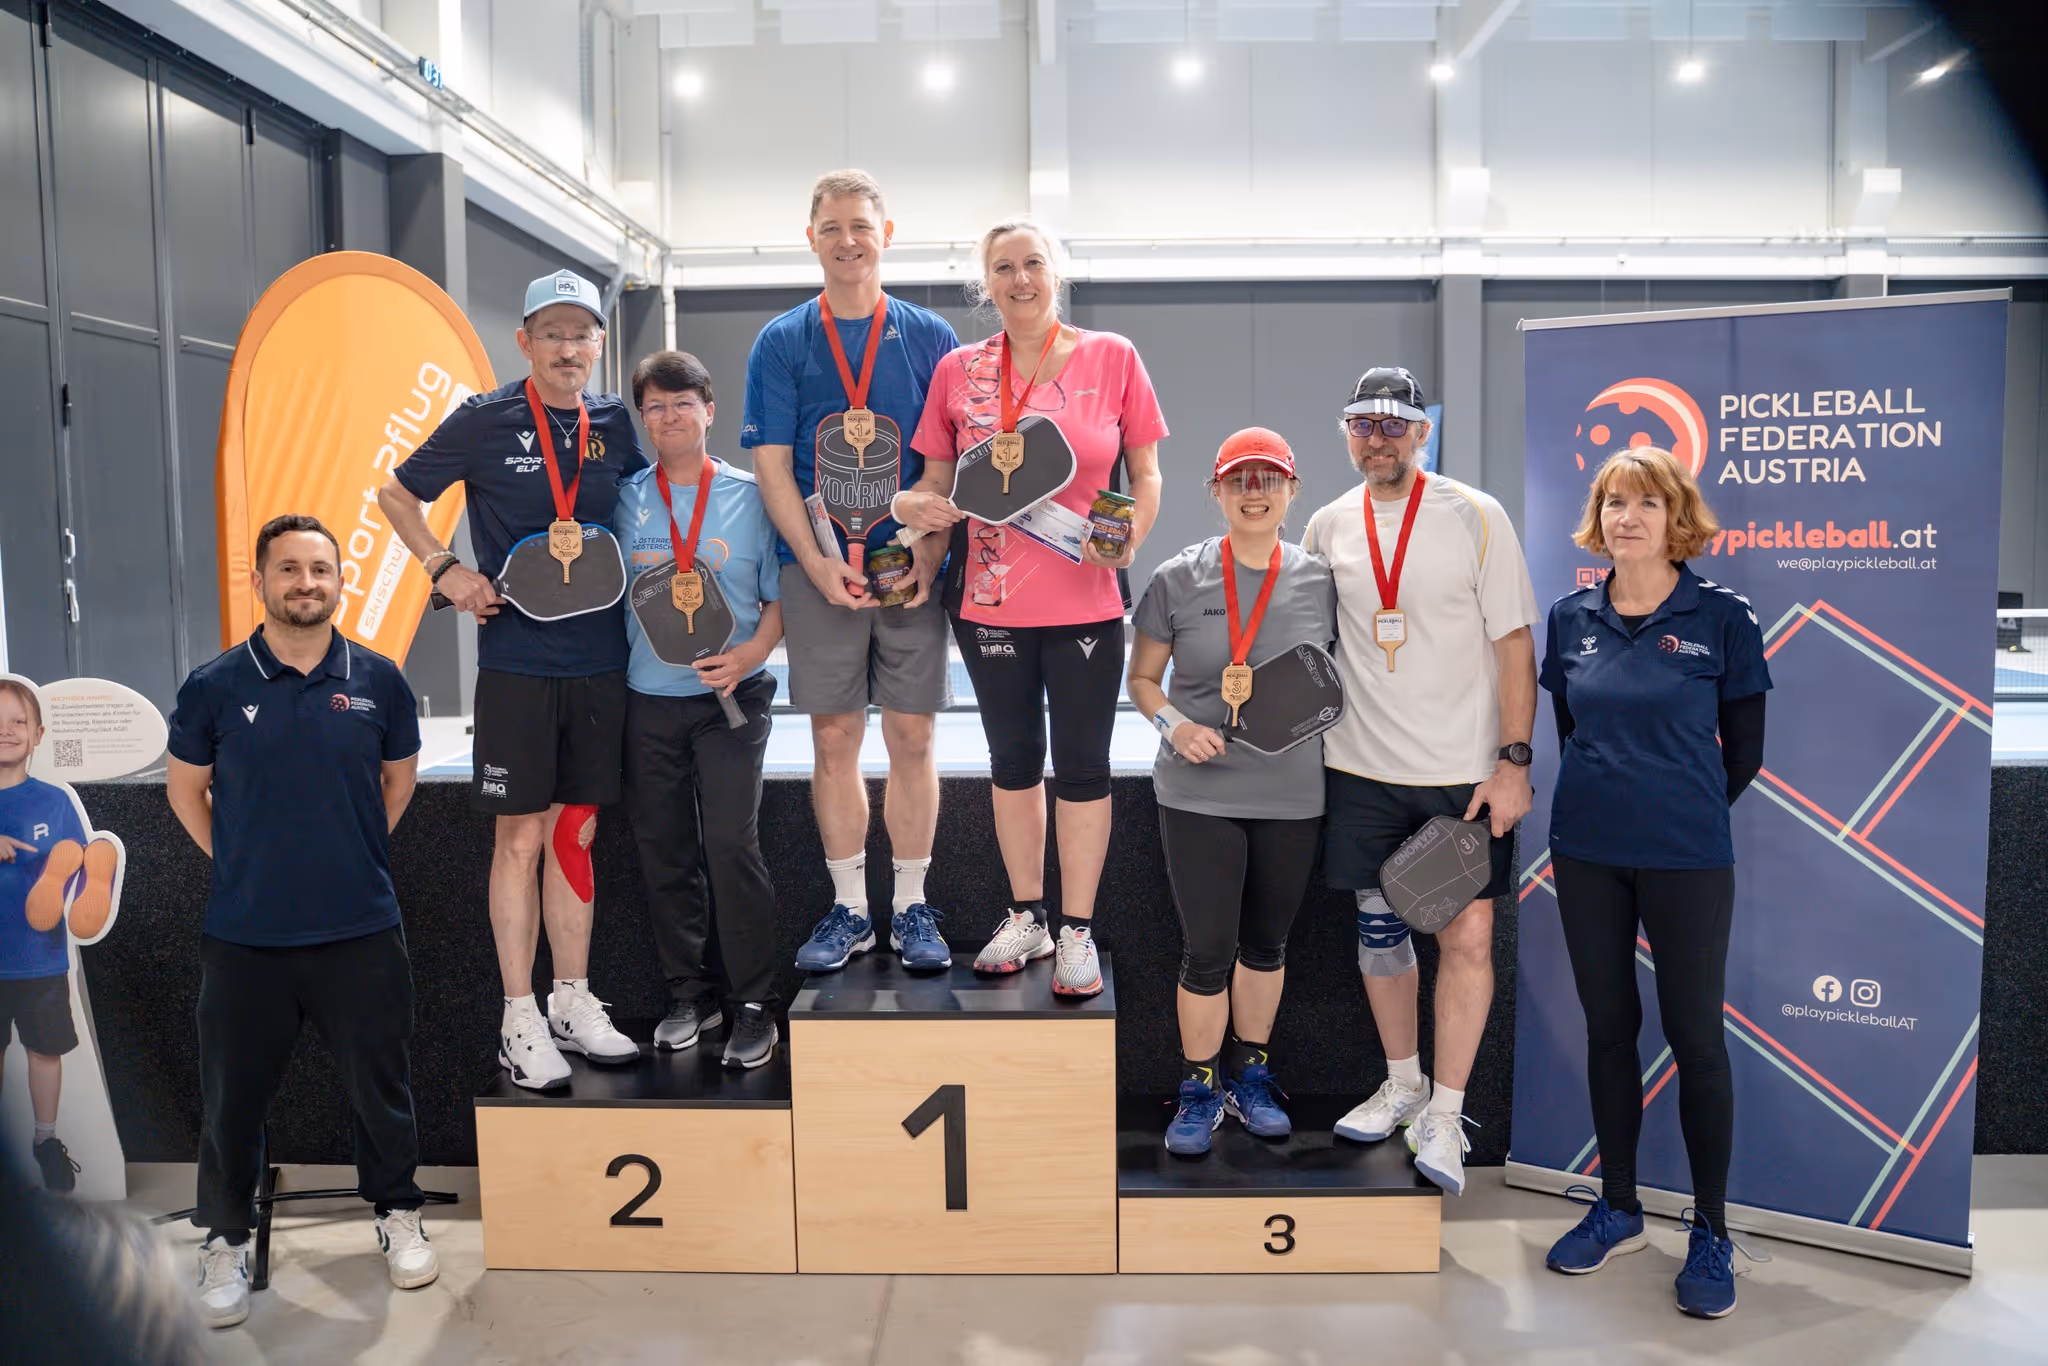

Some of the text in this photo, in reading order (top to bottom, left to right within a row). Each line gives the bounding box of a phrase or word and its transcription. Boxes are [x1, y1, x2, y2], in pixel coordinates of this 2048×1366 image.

[558, 283, 577, 293] PPA
[1720, 388, 1926, 420] PICKLEBALL
[854, 423, 863, 437] 1
[1720, 421, 1942, 452] FEDERATION
[1003, 446, 1010, 461] 1
[515, 465, 541, 473] ELF
[1718, 457, 1867, 485] AUSTRIA
[560, 537, 571, 550] 2
[1710, 520, 1938, 556] ypickleball.at
[1776, 557, 1938, 572] we@playpickleball.at
[683, 588, 693, 601] 2
[1203, 608, 1226, 616] JAKO
[1232, 681, 1241, 694] 3
[1781, 1003, 1919, 1031] @playpickleballAT
[901, 1085, 968, 1212] 1
[605, 1153, 663, 1228] 2
[1264, 1213, 1296, 1256] 3
